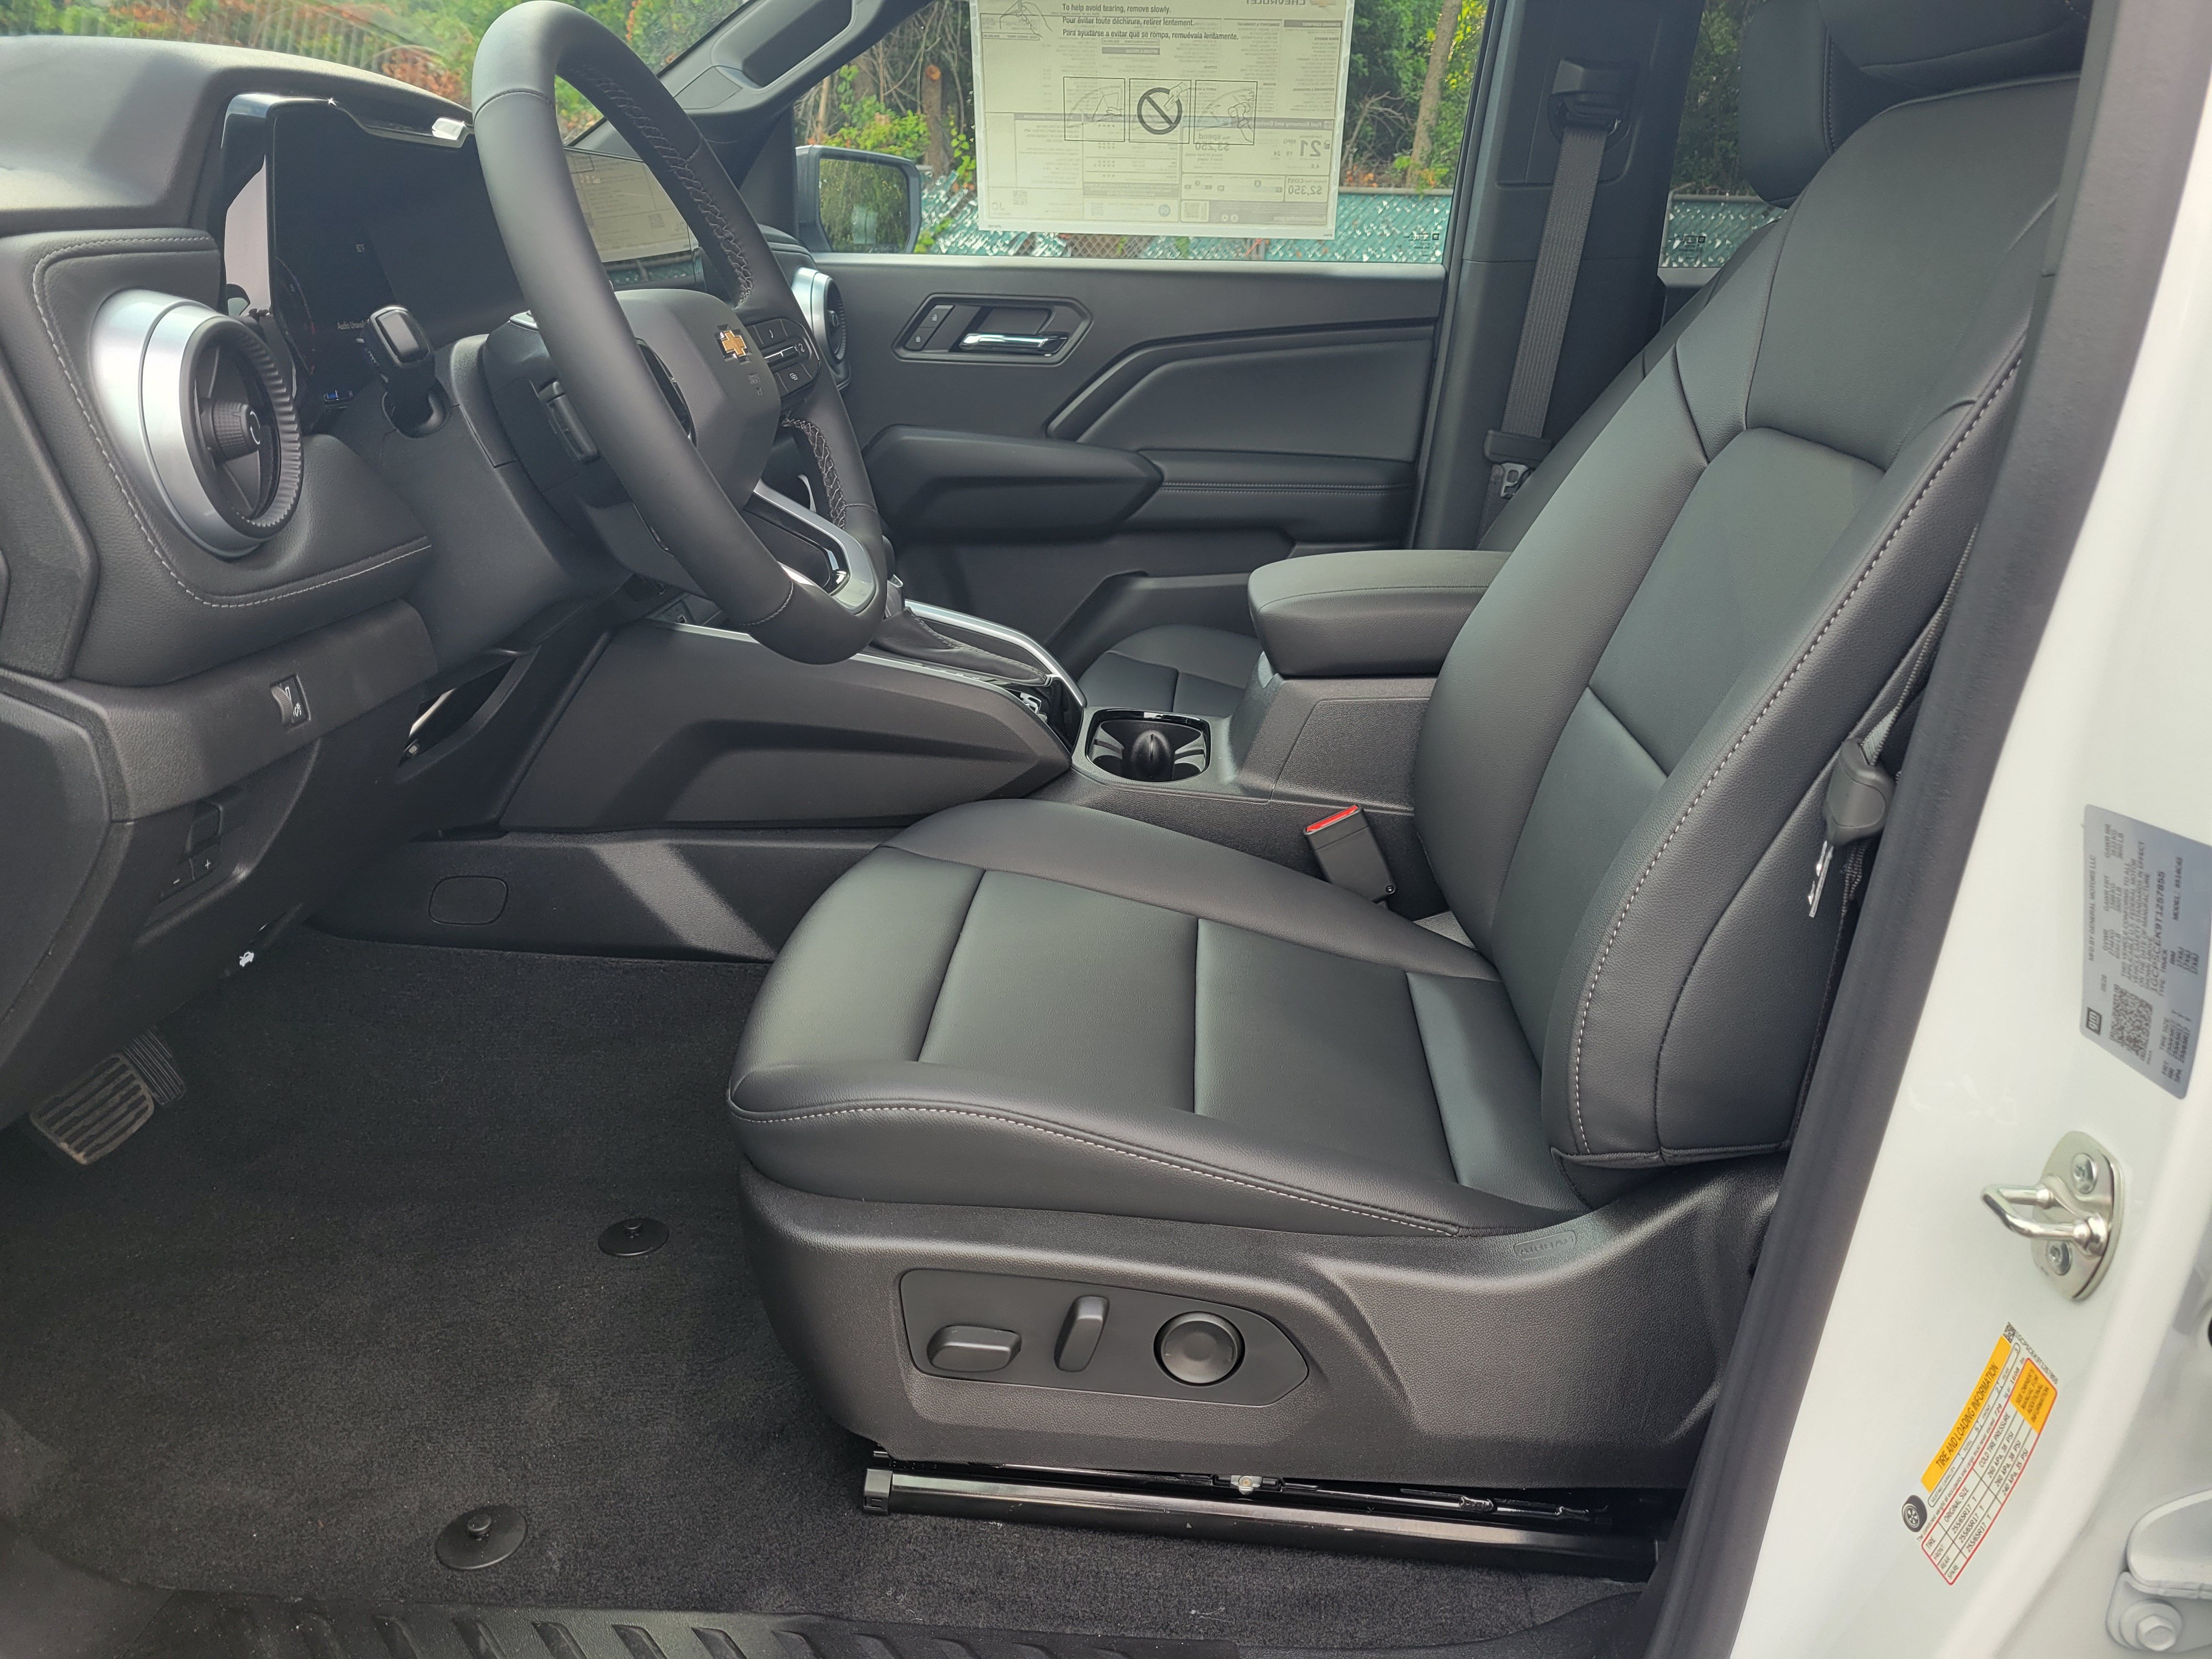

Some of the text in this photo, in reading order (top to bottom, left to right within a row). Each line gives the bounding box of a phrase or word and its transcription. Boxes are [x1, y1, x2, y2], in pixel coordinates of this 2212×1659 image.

[1151, 5, 1171, 14] slowly.
[1113, 17, 1142, 26] déchirure,
[1077, 30, 1104, 38] ayudarse
[2124, 875, 2129, 886] TO
[2089, 935, 2094, 945] BY
[1935, 1359, 1999, 1471] TIRE AND LOADING INFORMATION
[1962, 1437, 1973, 1453] TOTAL
[1924, 1410, 2011, 1550] TIRE ORIGINAL SIZE COLD TIRE PRESSURE
[1950, 1502, 1973, 1535] 255/65R17
[1986, 1464, 1996, 1479] 260
[2005, 1429, 2015, 1444] PSI
[1938, 1554, 1951, 1570] REAR
[1957, 1511, 1980, 1544] 255/65R17
[1994, 1473, 2004, 1488] 260
[2012, 1438, 2022, 1453] PSI
[1965, 1520, 1988, 1554] 255/65R17
[2001, 1482, 2011, 1497] 240
[2019, 1446, 2029, 1462] PSI
